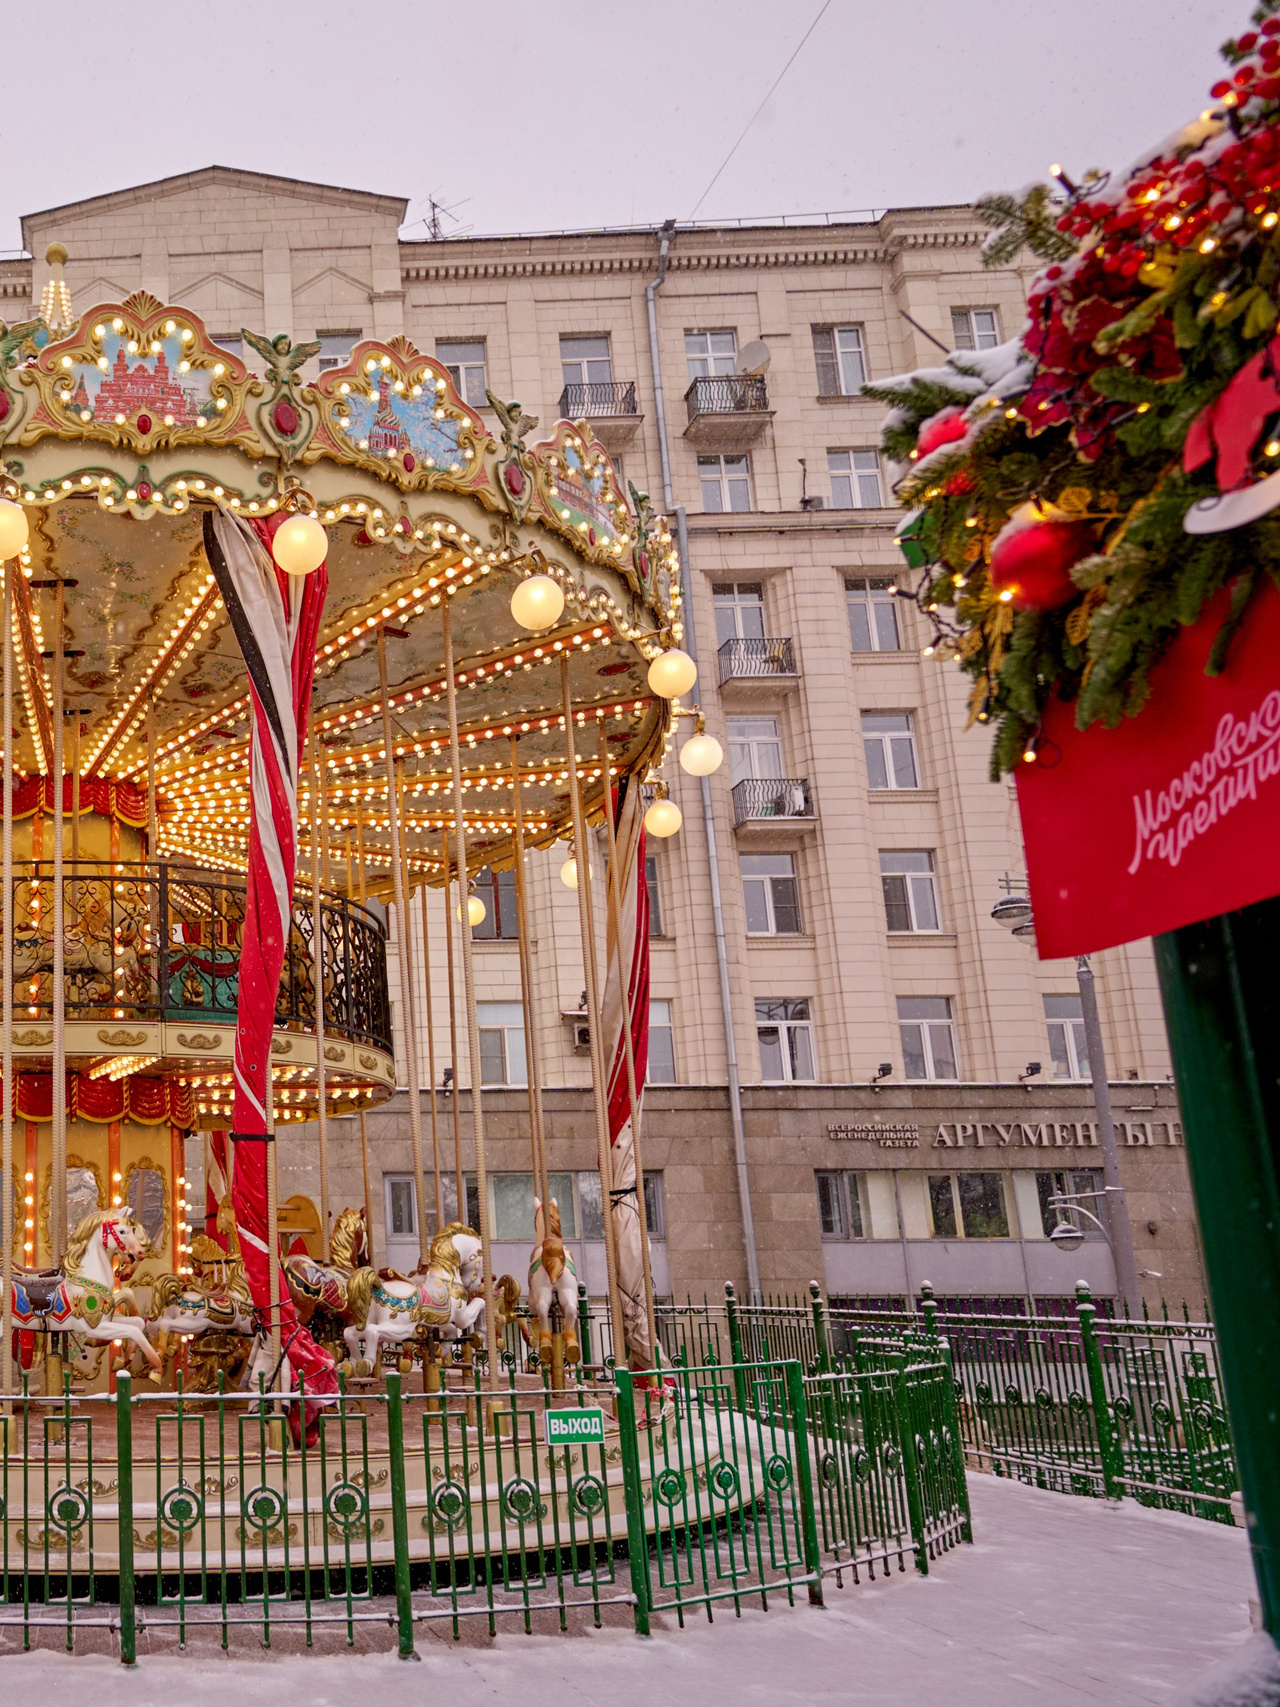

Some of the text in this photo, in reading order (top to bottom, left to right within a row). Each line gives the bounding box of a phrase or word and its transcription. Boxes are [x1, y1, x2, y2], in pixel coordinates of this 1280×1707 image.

[1128, 690, 1280, 875] Московско
[1147, 727, 1280, 866] чаепити
[827, 1123, 919, 1132] ВСЕРОССИЙСКАЯ
[830, 1132, 919, 1141] ЕЖЕНЕДЕЛЬНАЯ
[880, 1140, 920, 1148] ГАЗЕТА
[550, 1417, 602, 1435] ВЫХОД
